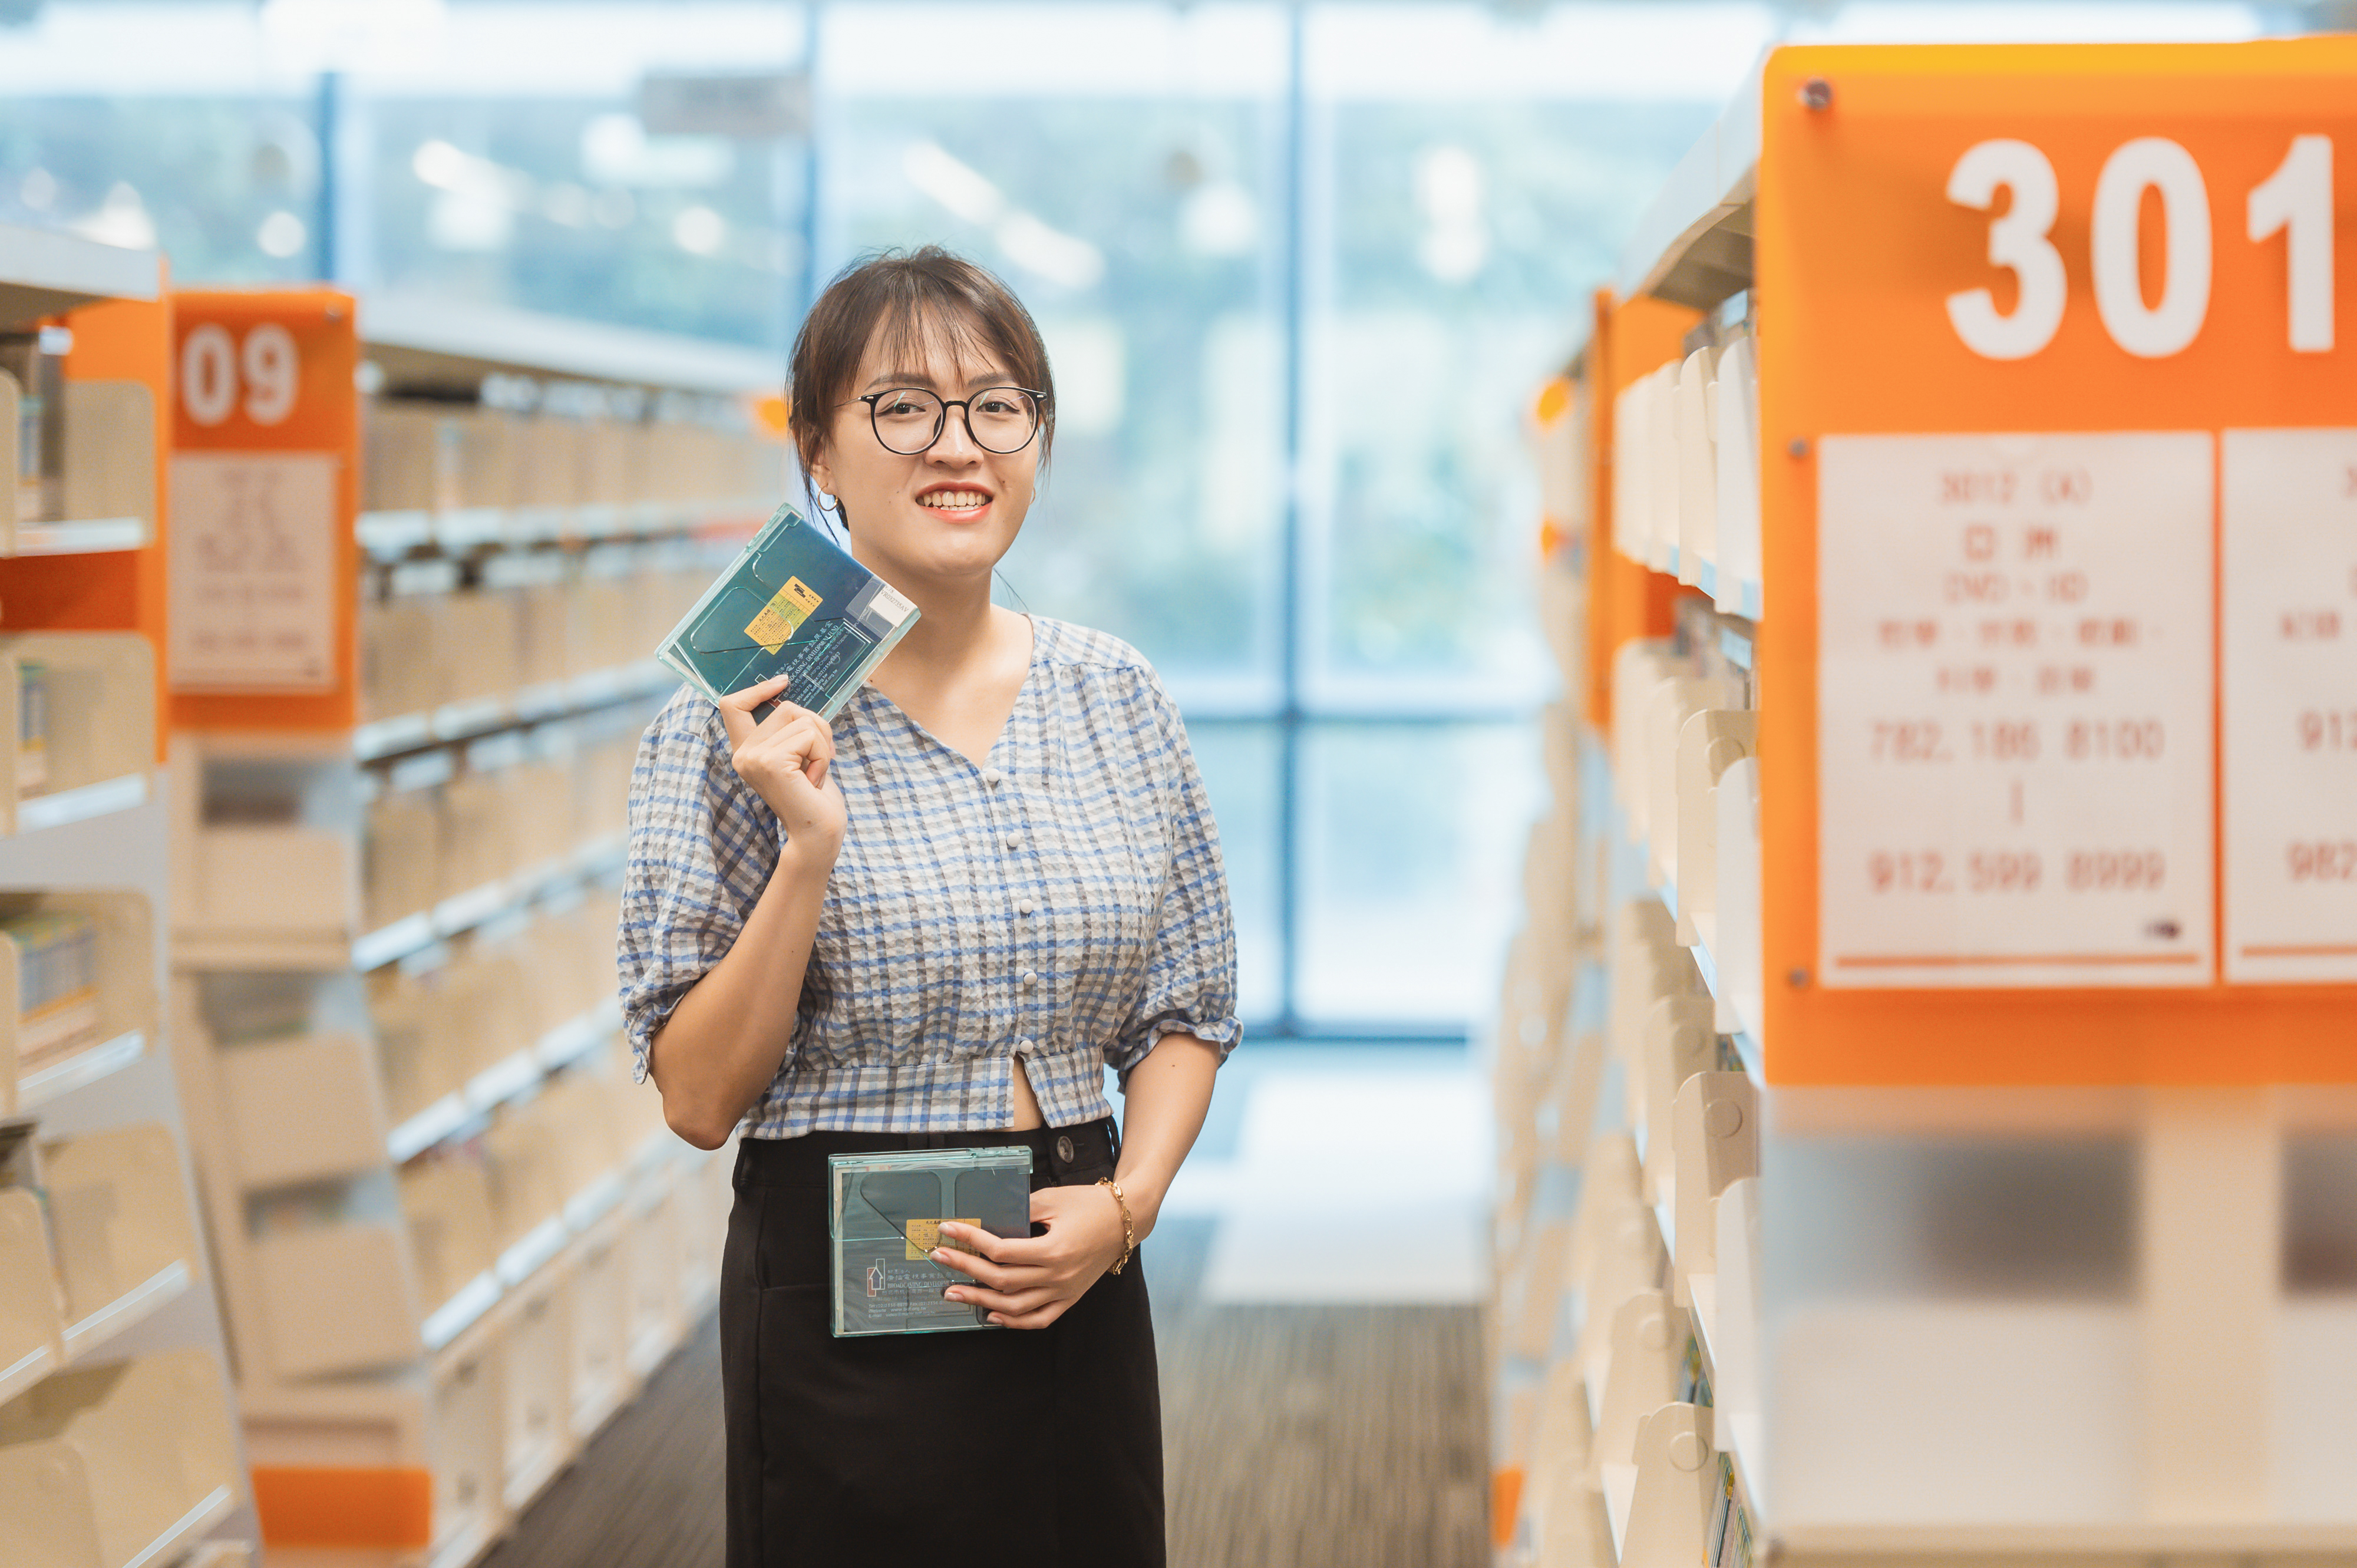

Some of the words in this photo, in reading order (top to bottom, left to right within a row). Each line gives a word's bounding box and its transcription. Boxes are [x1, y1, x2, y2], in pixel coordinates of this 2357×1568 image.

[1946, 135, 2334, 361] 301
[881, 590, 909, 612] VR032735AV
[781, 619, 834, 675] 電視事業發展基金
